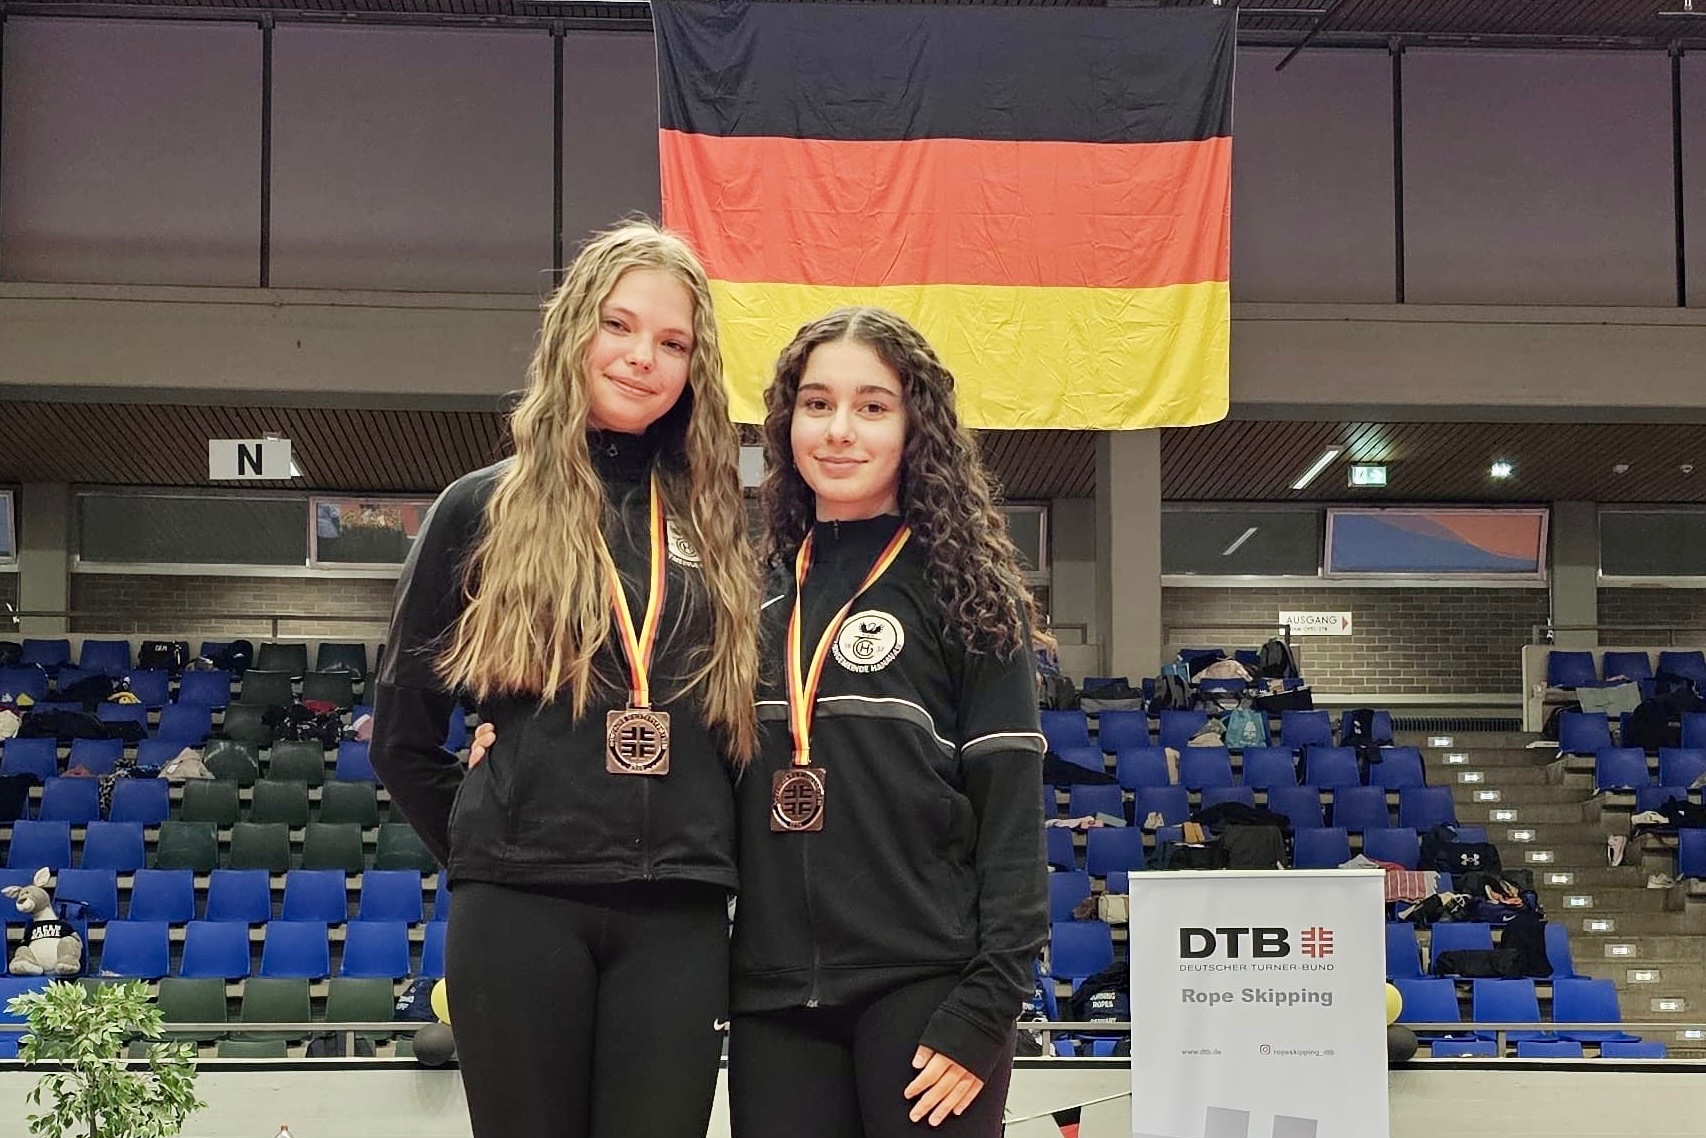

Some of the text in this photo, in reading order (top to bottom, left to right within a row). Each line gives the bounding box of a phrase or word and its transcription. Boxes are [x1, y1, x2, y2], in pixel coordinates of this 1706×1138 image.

[237, 443, 263, 476] N
[1286, 615, 1338, 625] AUSGANG
[1179, 927, 1291, 959] DTB
[1179, 963, 1247, 972] DEUTSCHER
[1181, 988, 1333, 1007] Rope Skipping
